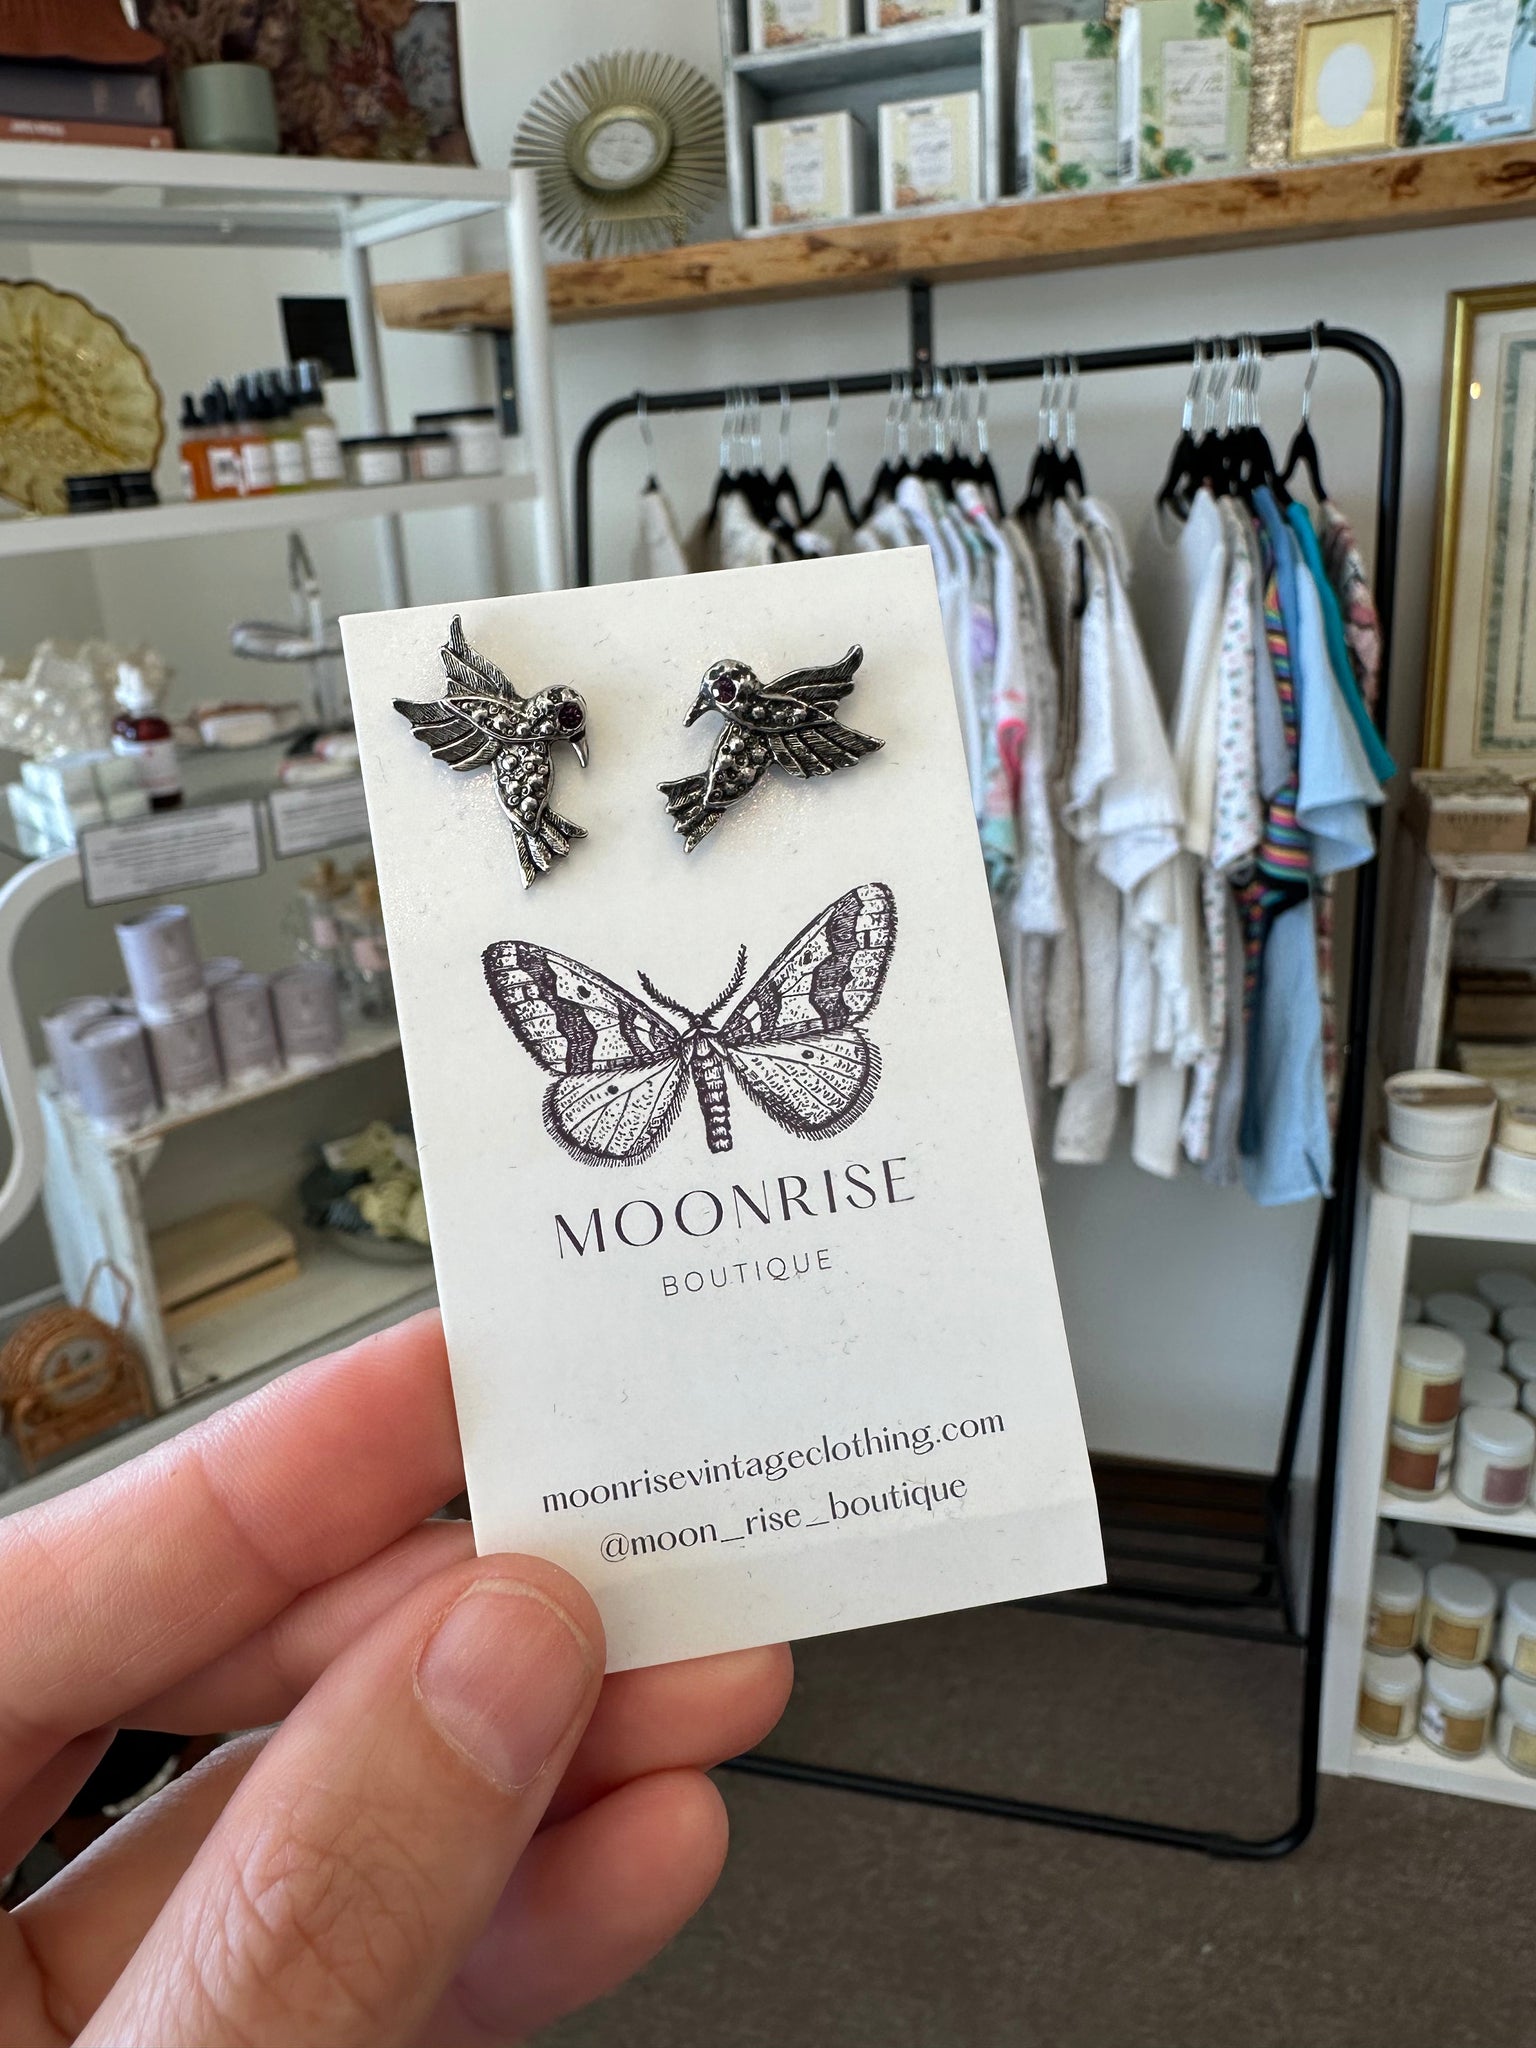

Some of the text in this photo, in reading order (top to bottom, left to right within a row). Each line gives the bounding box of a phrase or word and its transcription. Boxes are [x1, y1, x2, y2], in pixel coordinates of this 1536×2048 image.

[555, 1157, 915, 1259] MOONRISE
[662, 1249, 832, 1297] BOUTIQUE
[542, 1411, 1005, 1513] moonrisevintageclothing.com
[601, 1477, 968, 1563] @moon_rise_boutique
